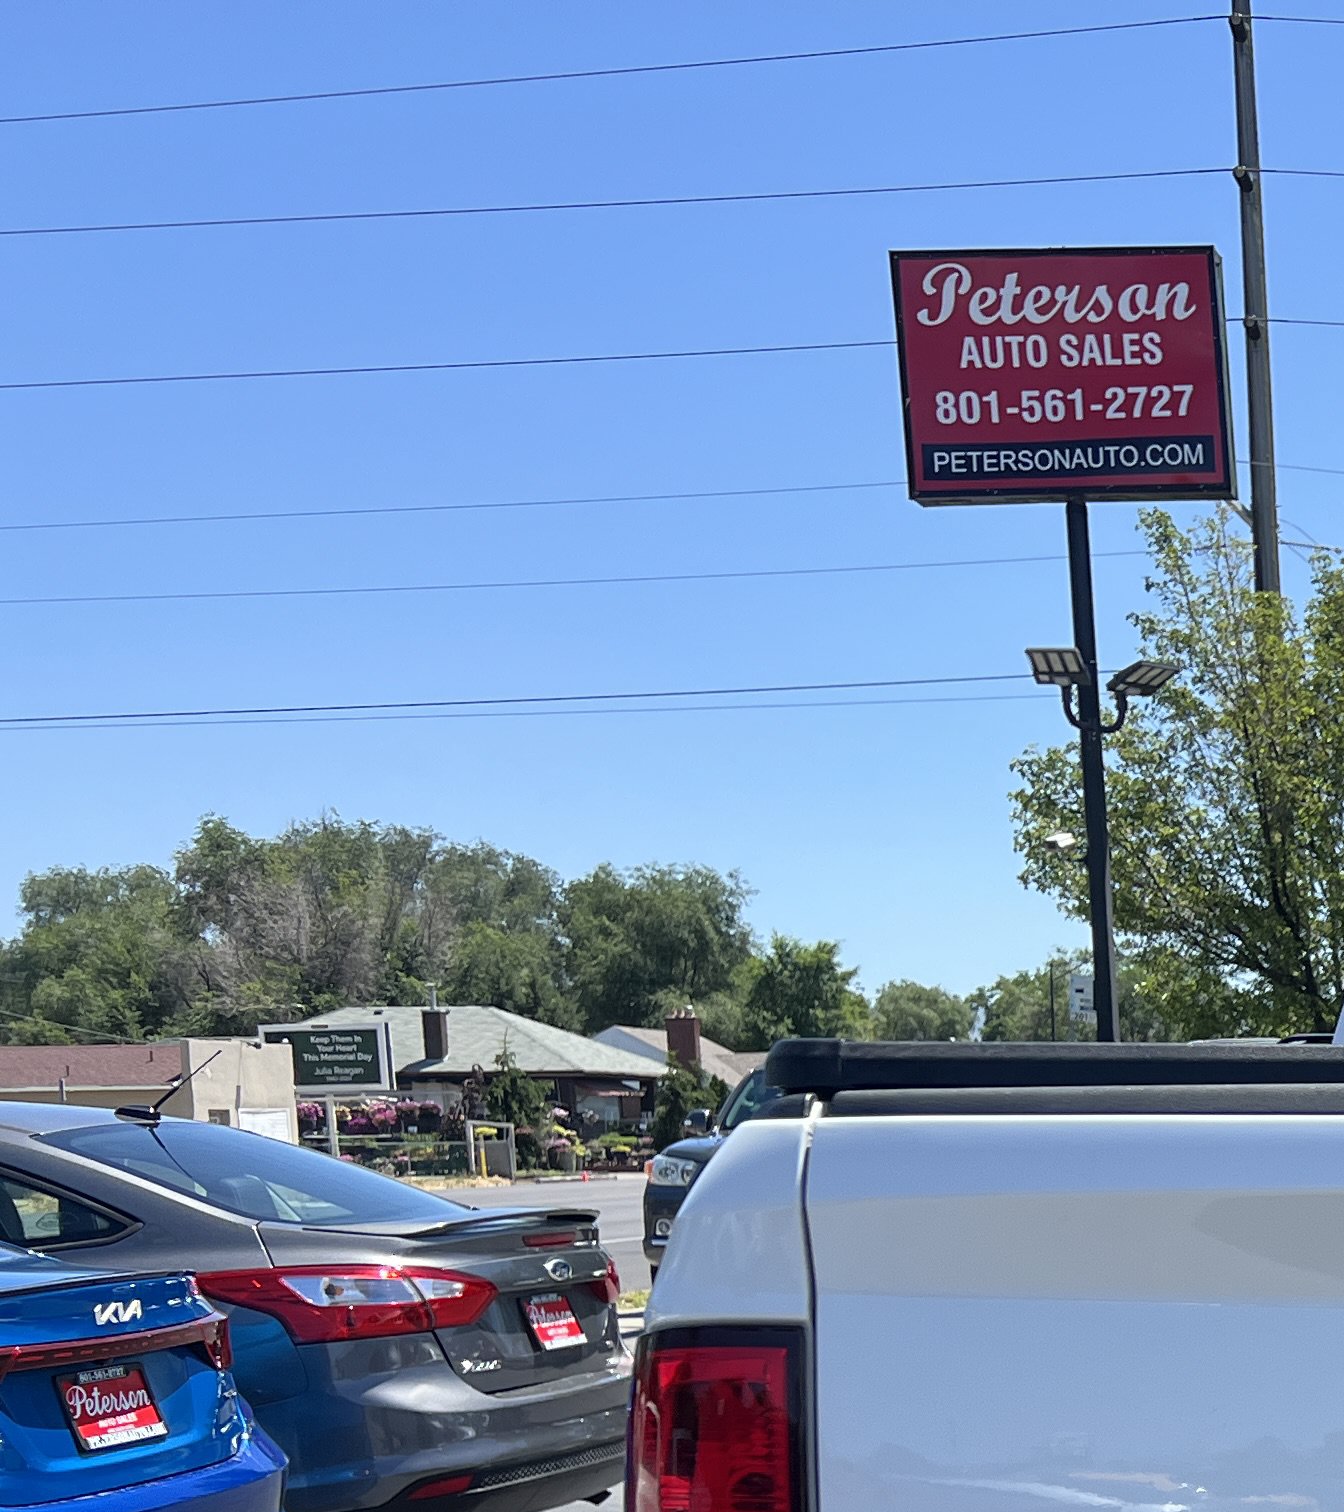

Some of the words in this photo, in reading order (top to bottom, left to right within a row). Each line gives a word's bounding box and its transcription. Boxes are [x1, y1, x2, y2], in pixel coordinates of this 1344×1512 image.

[917, 262, 1197, 326] Peterson
[960, 335, 1047, 369] AUTO
[1060, 332, 1163, 367] SALES
[935, 384, 1194, 425] 801-561-2727
[933, 443, 1204, 473] PETERSONAUTO.COM
[93, 1299, 143, 1325] KIA
[66, 1385, 151, 1419] Peterson
